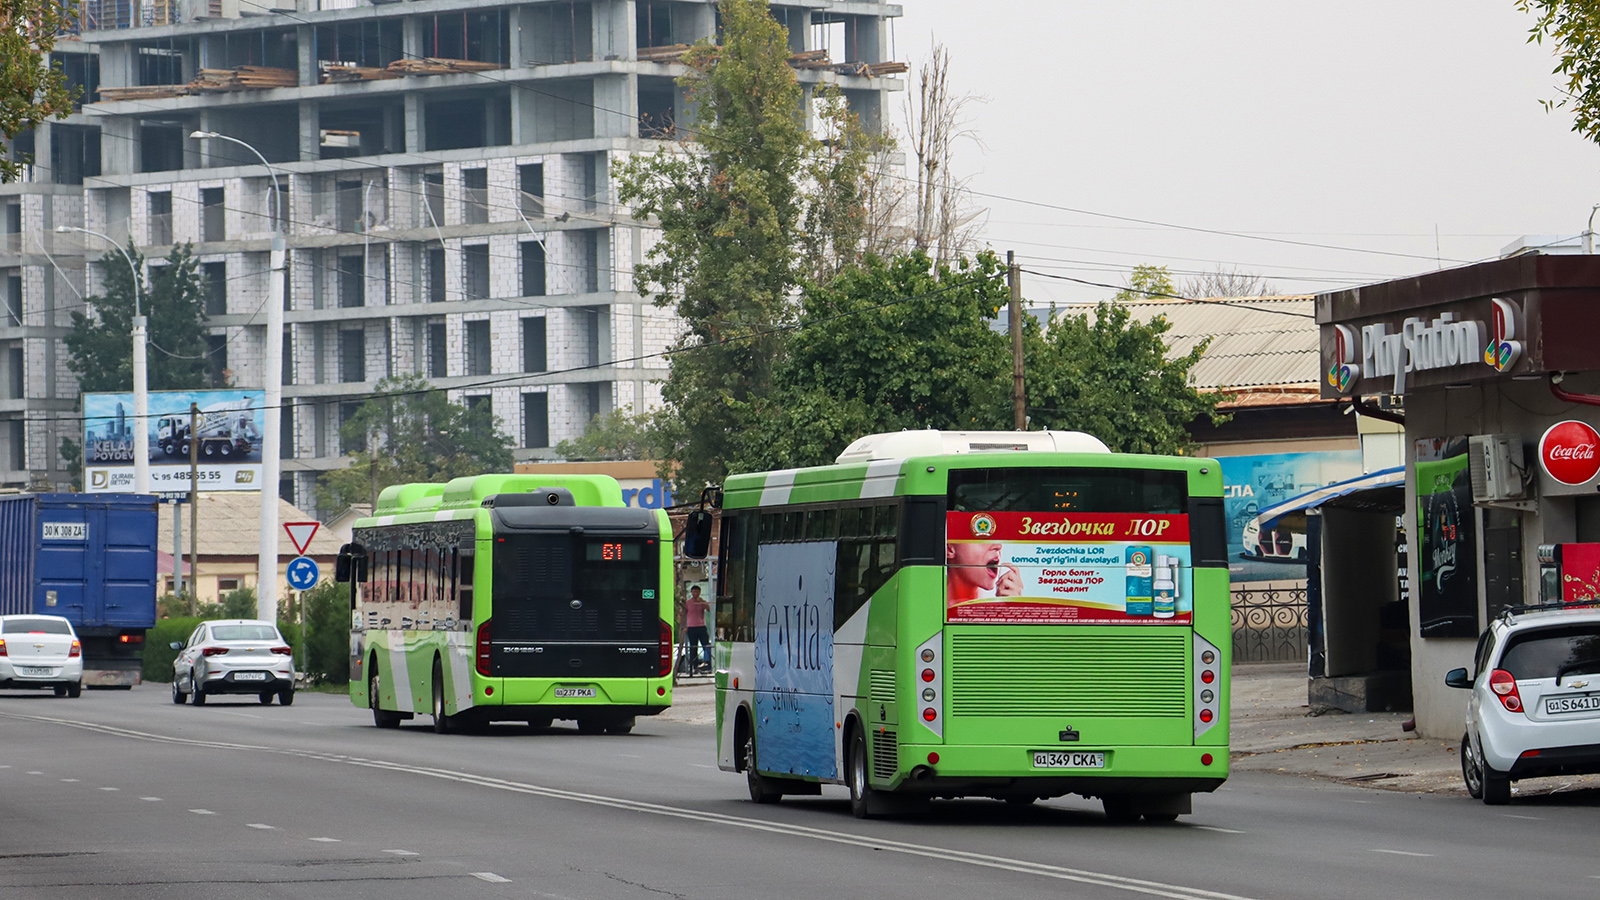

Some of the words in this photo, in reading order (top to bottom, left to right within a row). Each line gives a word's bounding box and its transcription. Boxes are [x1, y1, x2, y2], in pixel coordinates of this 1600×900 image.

[1362, 312, 1480, 394] PlayStation
[1550, 443, 1597, 461] Coca-Cola
[173, 472, 191, 480] 485
[208, 471, 221, 480] 55
[44, 525, 52, 536] 30
[54, 526, 59, 536] K
[60, 525, 72, 536] 308
[74, 526, 82, 536] ZA
[1018, 516, 1115, 535] Звездочка
[1125, 519, 1170, 536] ЛОР
[602, 543, 622, 560] 61
[1087, 547, 1105, 555] LOR
[1011, 556, 1039, 564] tomoq
[1079, 556, 1120, 565] davolaydi
[1042, 569, 1067, 577] Горло
[1069, 569, 1094, 577] болит
[1038, 577, 1083, 585] Звездочка
[563, 688, 576, 696] 237
[577, 688, 592, 696] PKA
[772, 687, 799, 711] SENING
[1549, 702, 1559, 710] 01
[1561, 699, 1570, 711] S
[1571, 698, 1591, 709] 641
[1036, 755, 1047, 764] 01
[1049, 754, 1070, 766] 349
[1073, 754, 1097, 766] CKA
